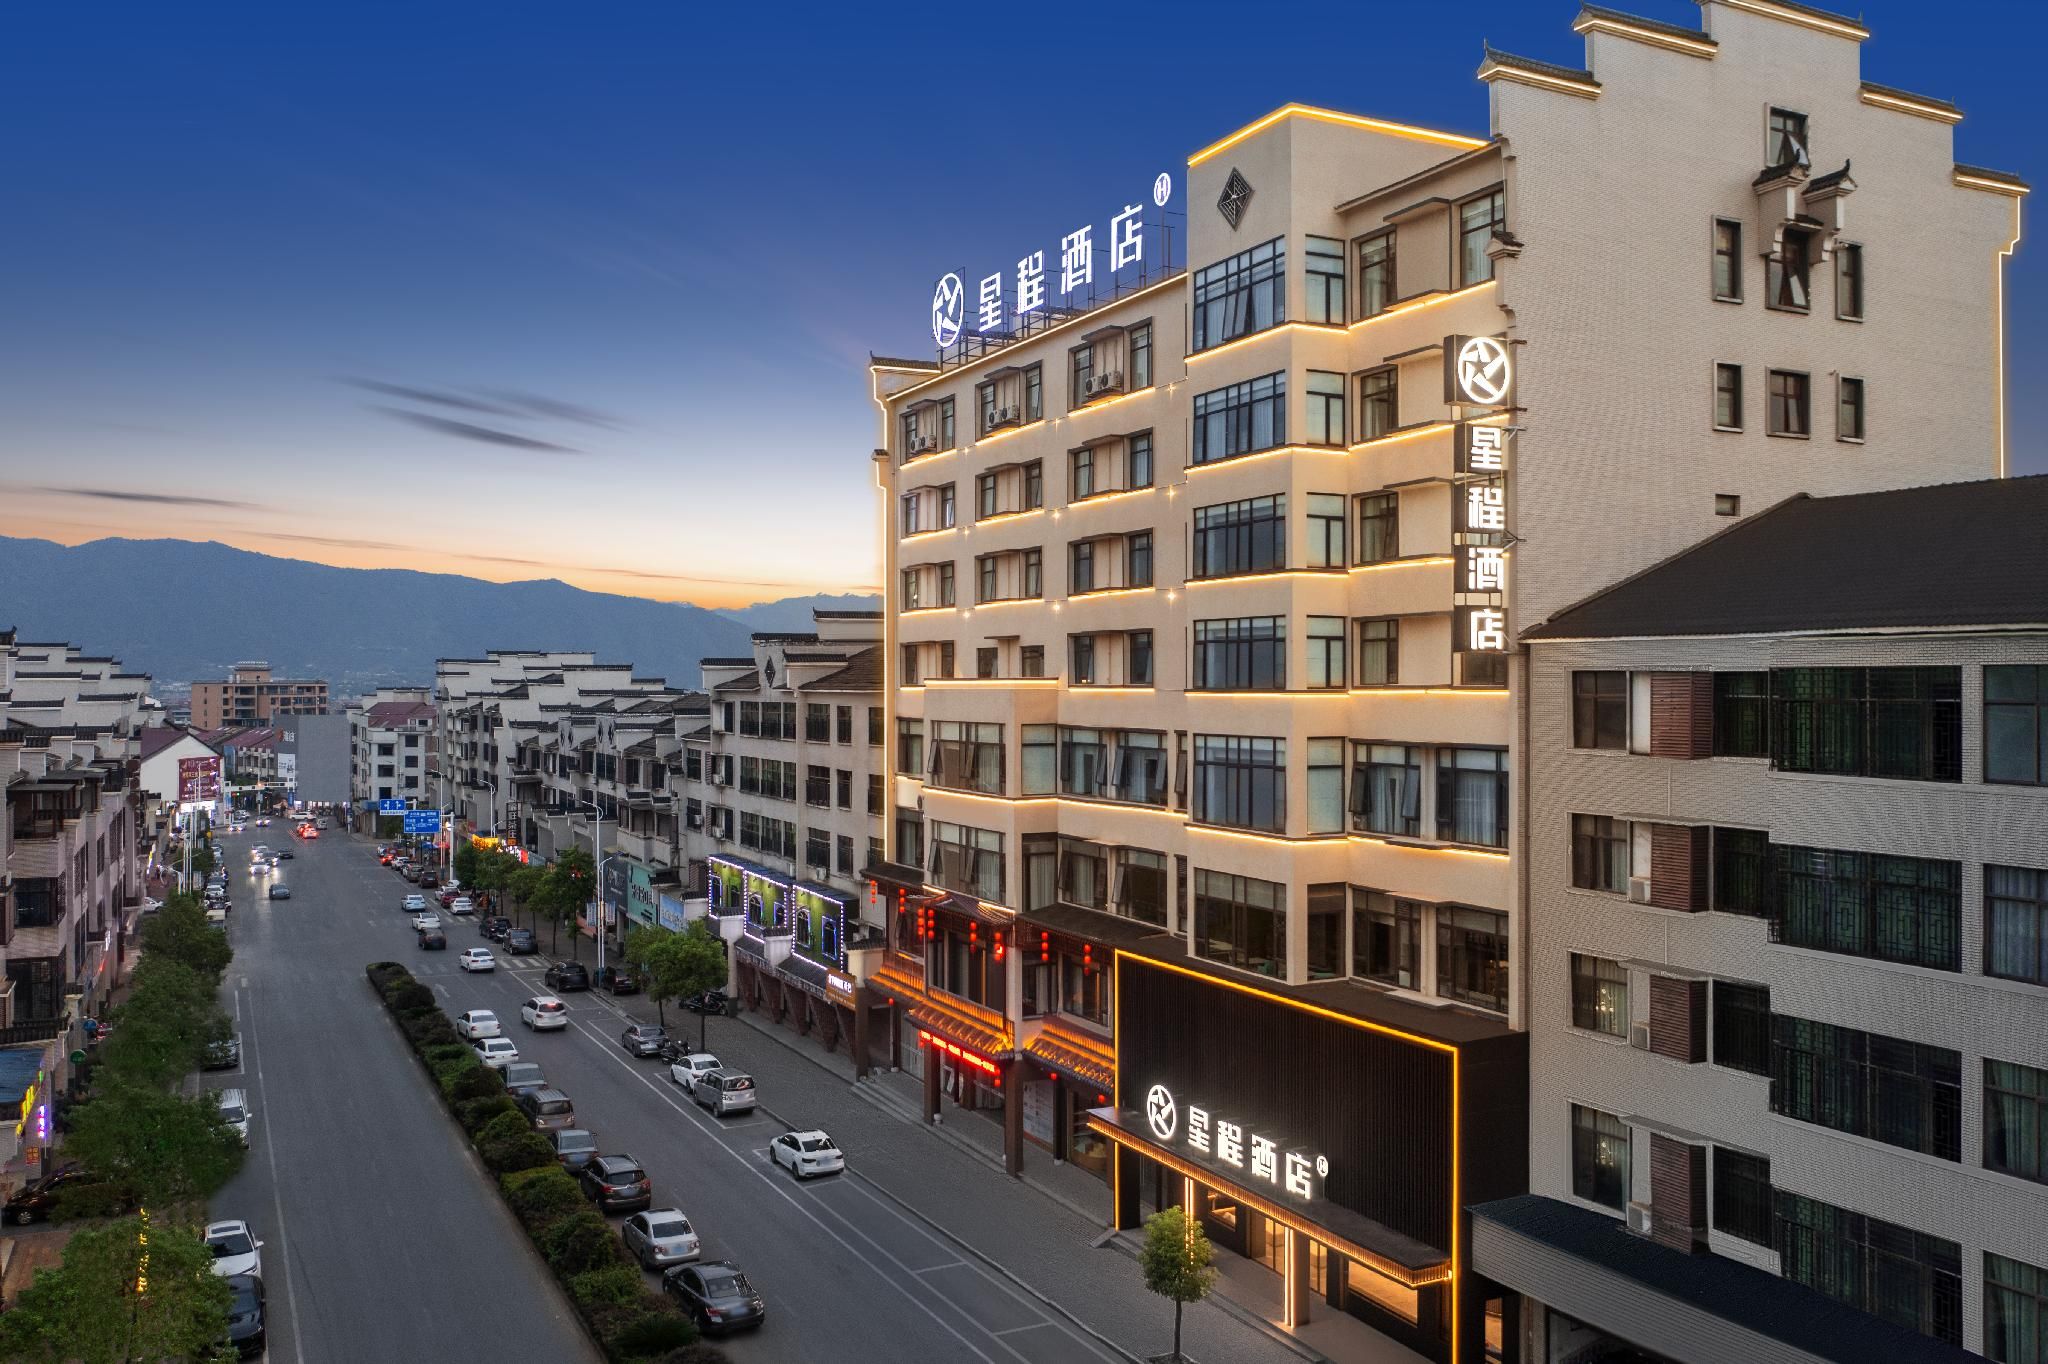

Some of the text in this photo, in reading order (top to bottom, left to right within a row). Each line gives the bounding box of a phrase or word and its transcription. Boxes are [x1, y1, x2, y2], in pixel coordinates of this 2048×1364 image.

[979, 204, 1143, 332] 星程酒店
[1468, 426, 1505, 650] 星程酒店
[1188, 1105, 1312, 1200] 星程酒店
